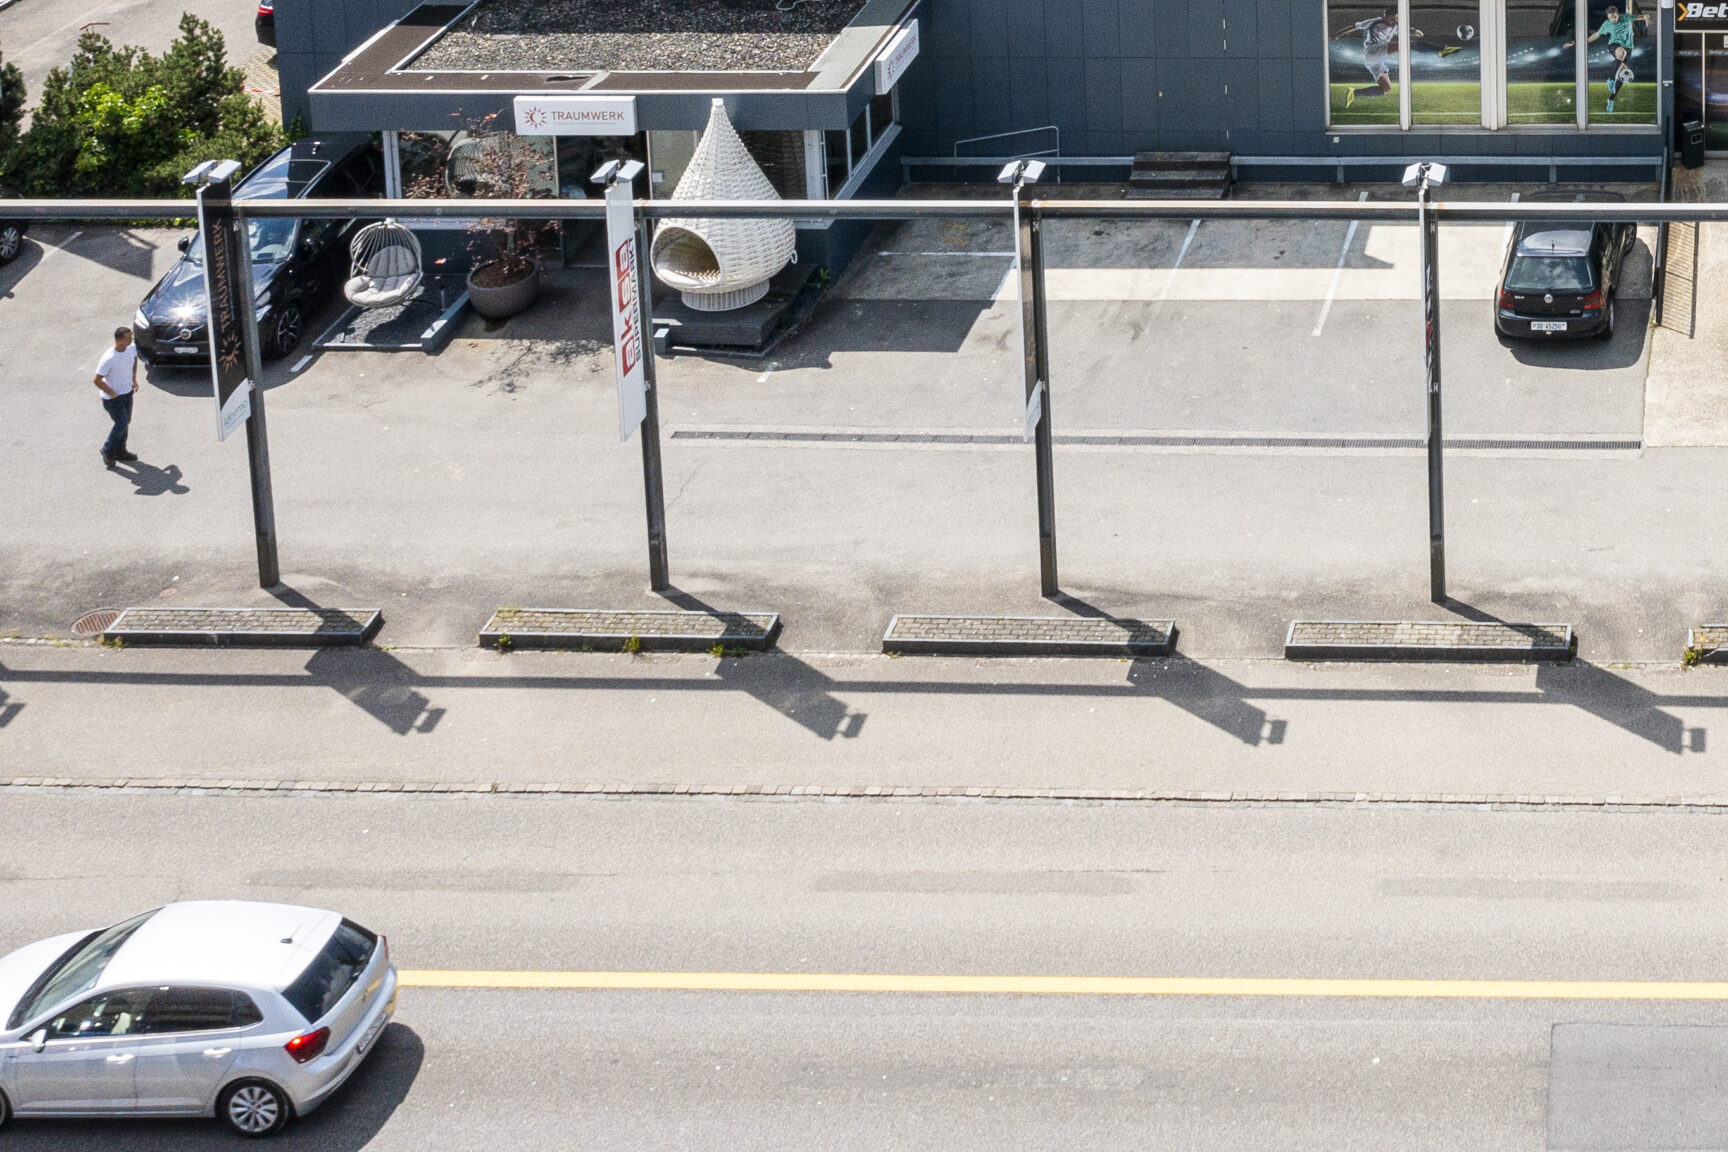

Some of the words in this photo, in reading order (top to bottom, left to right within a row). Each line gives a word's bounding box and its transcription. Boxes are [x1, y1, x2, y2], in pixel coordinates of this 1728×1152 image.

[551, 111, 625, 121] TRAUMWERK
[212, 218, 230, 332] TRAUMWERK
[627, 235, 641, 362] SUPERMARKT
